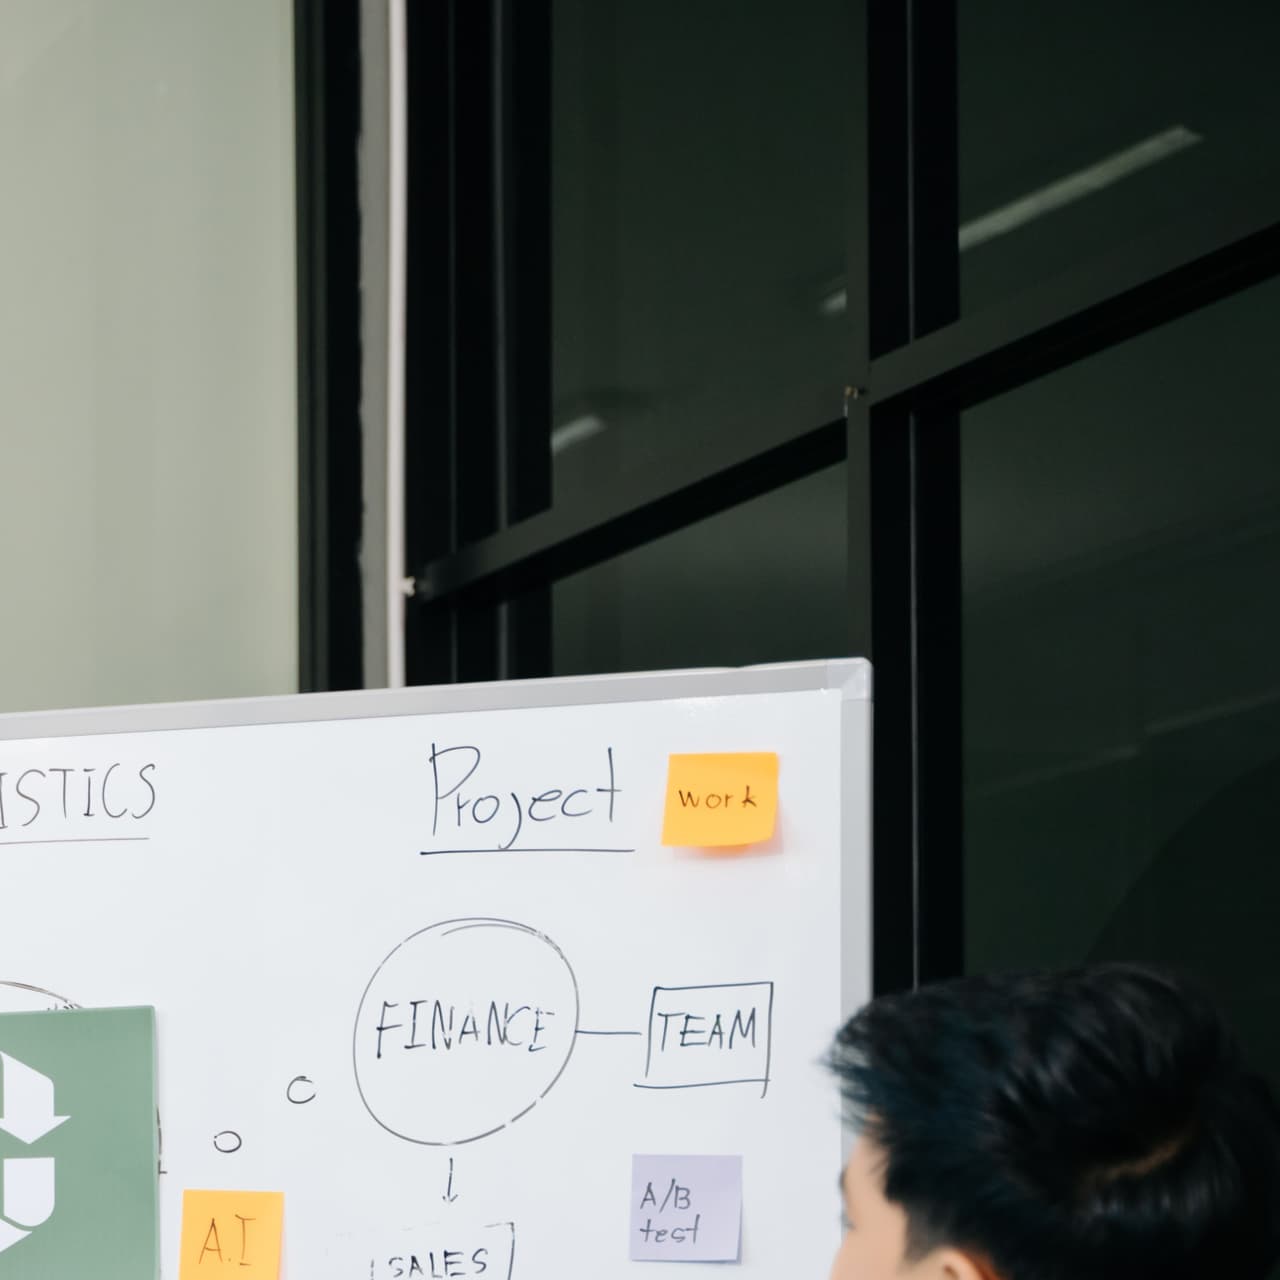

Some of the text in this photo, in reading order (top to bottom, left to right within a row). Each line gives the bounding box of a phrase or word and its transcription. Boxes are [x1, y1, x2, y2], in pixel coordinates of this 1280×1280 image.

[428, 742, 622, 850] Project
[677, 784, 759, 811] work
[375, 999, 556, 1060] FINANCE
[656, 1006, 757, 1052] TEAM
[639, 1177, 691, 1213] A/B
[639, 1214, 701, 1244] test
[388, 1247, 488, 1279] SALES
